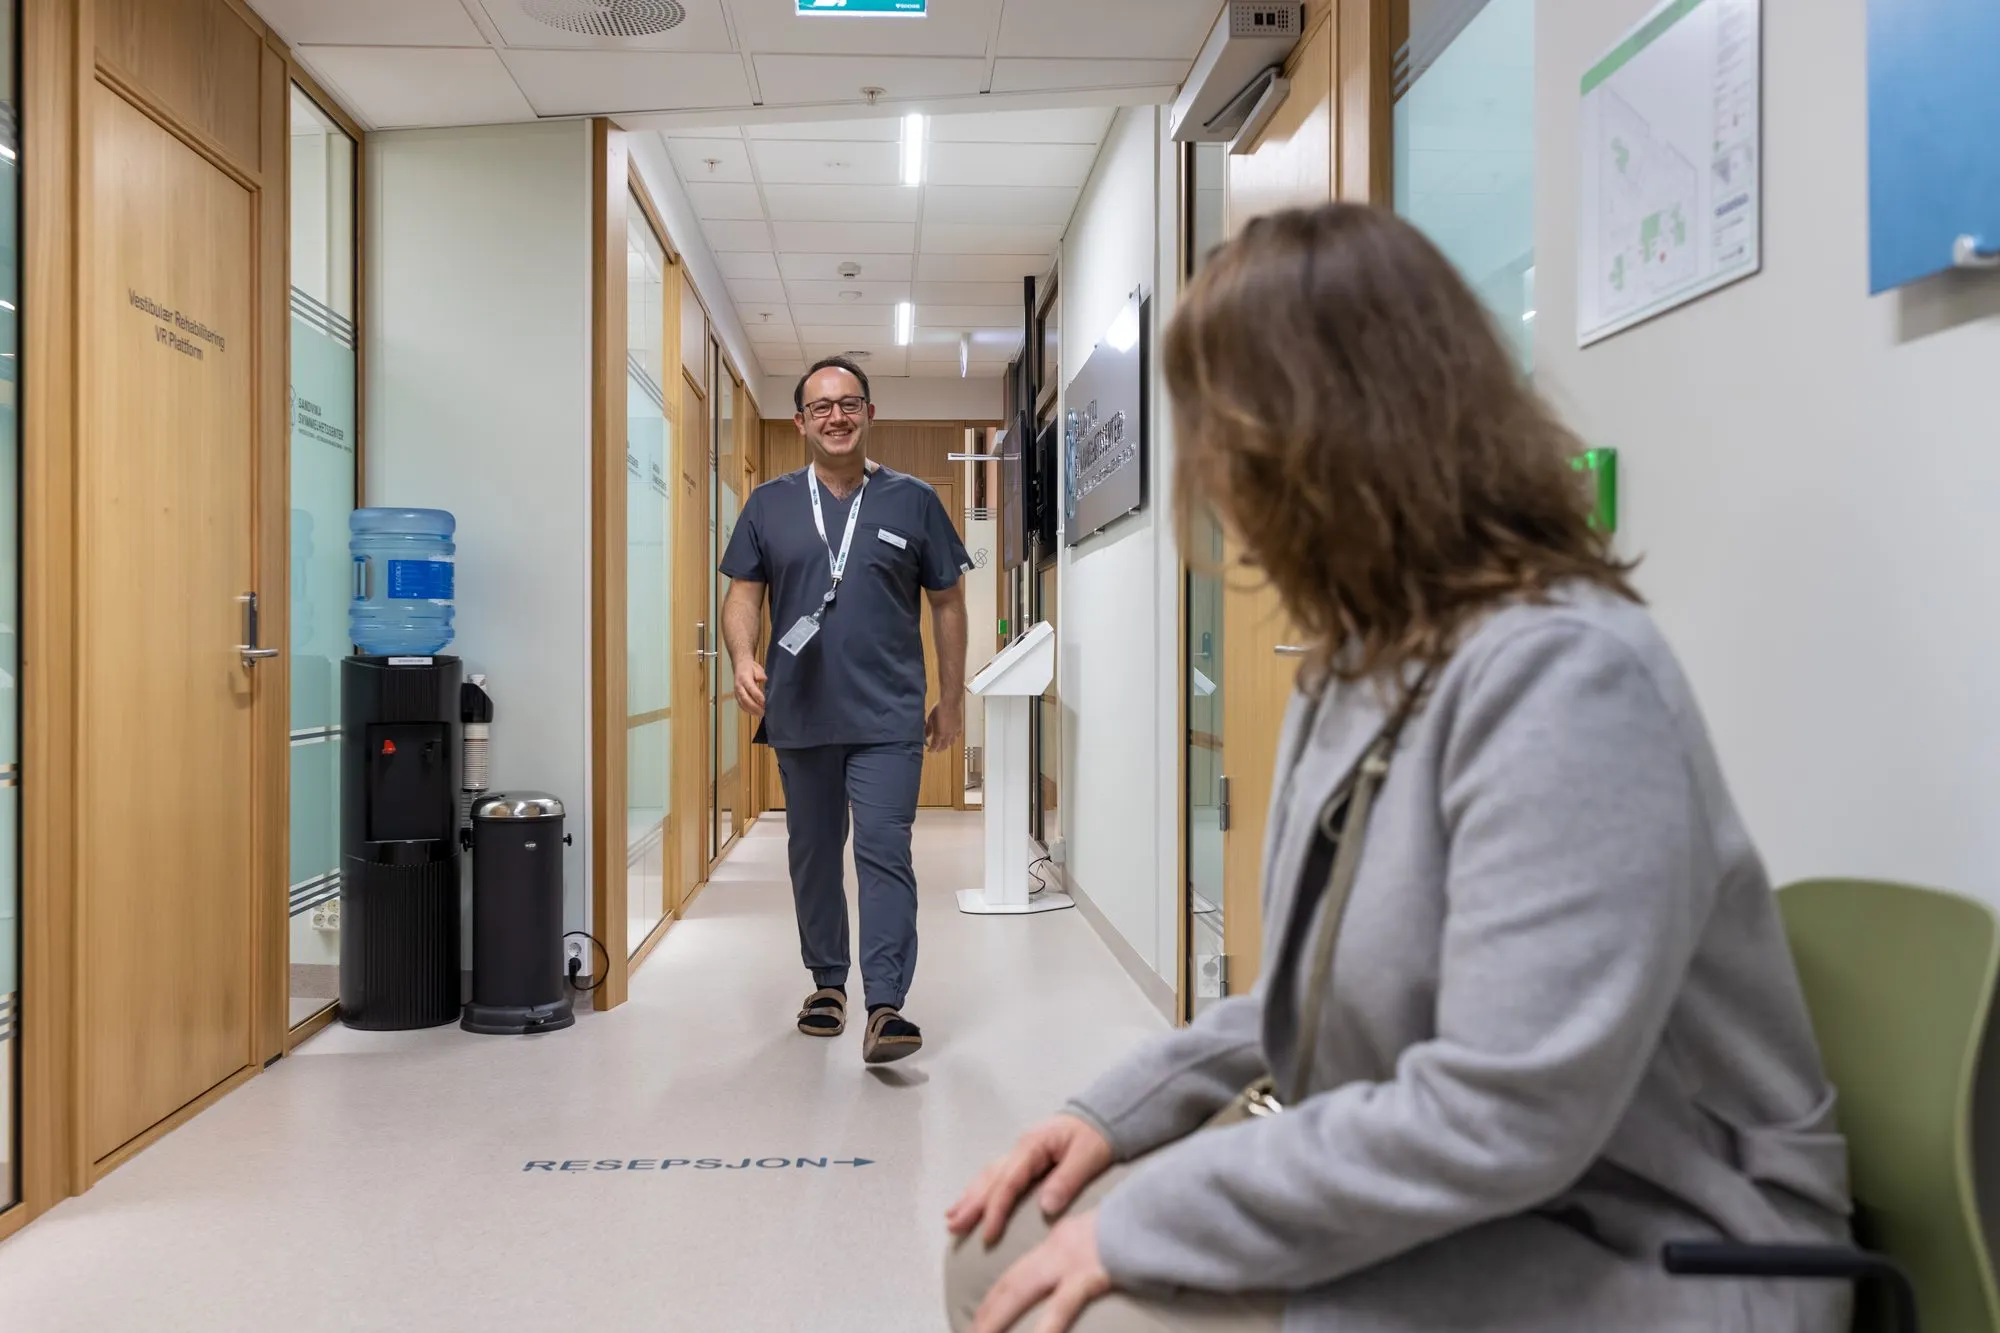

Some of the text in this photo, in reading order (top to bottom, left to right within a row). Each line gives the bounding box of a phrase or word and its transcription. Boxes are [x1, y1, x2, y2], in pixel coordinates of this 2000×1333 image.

[128, 287, 225, 353] Vestibulær Rehabilitering
[155, 324, 204, 361] VR Plattform
[522, 1157, 828, 1173] RESEPSJON
